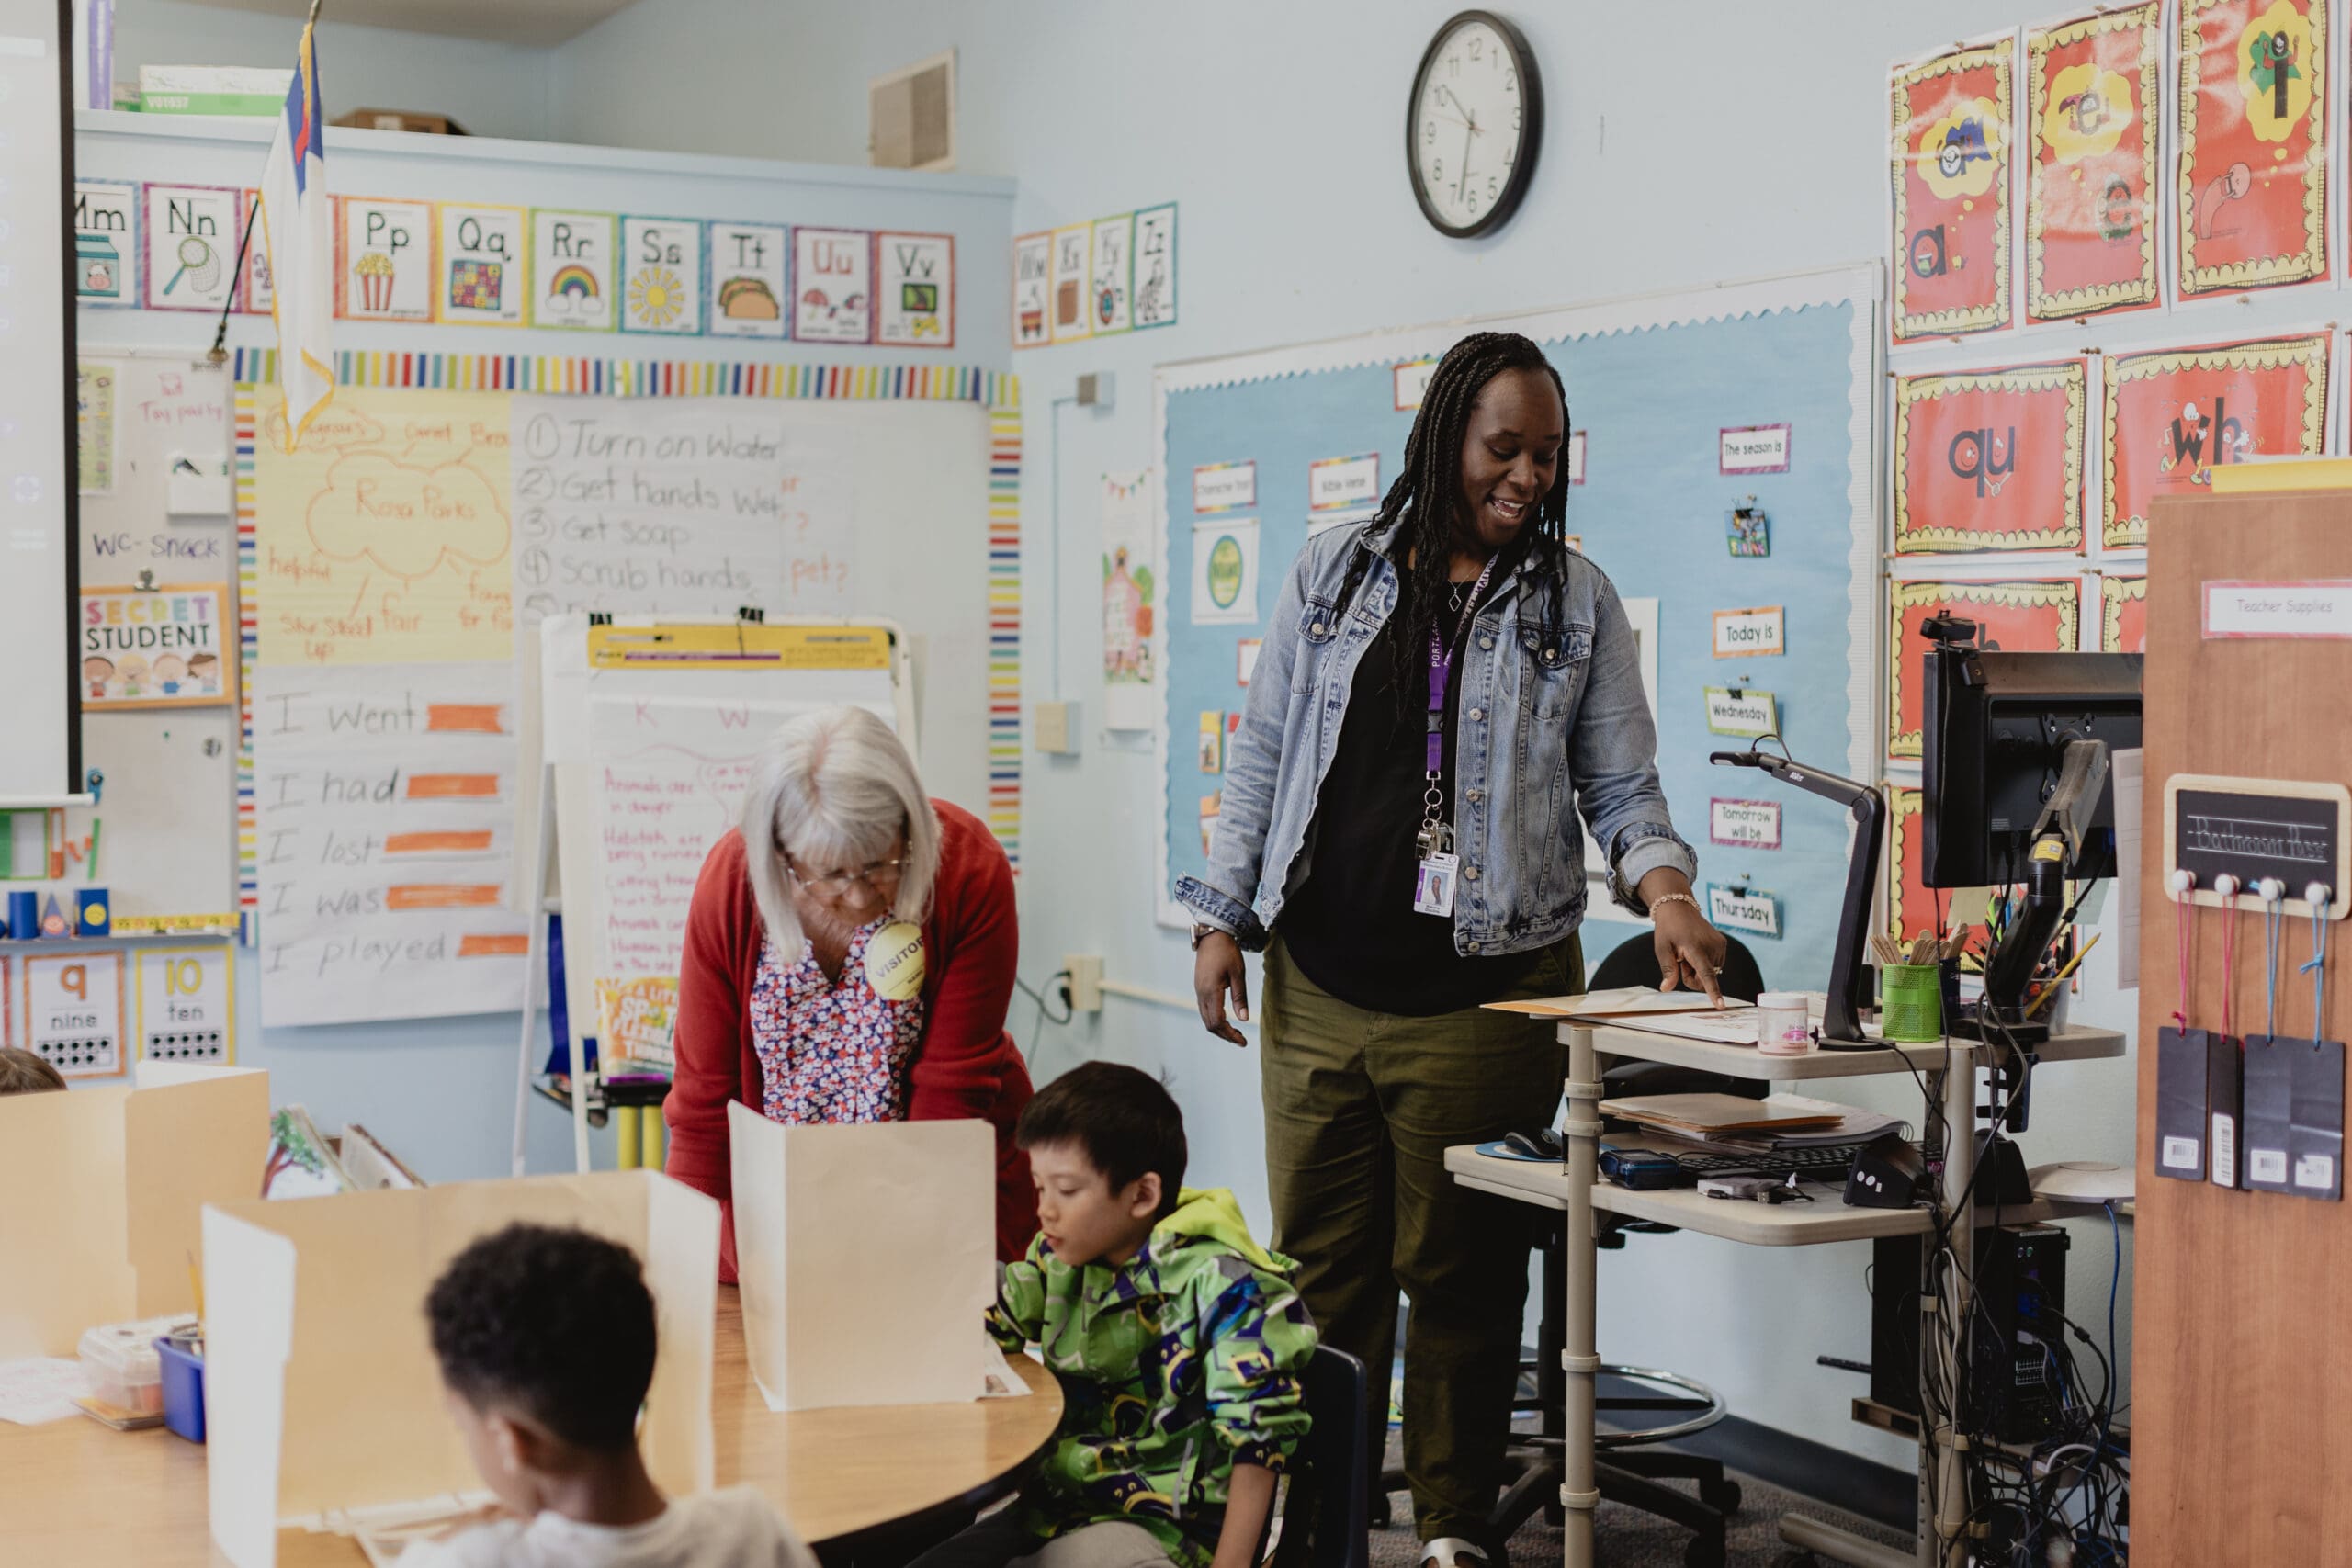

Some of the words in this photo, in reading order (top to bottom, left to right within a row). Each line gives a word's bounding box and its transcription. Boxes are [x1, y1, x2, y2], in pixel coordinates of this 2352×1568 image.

[1469, 38, 1483, 62] 12
[1449, 58, 1460, 78] 11
[1506, 68, 1515, 92] 2
[1434, 85, 1448, 107] 10
[1427, 121, 1436, 145] 9
[1433, 158, 1442, 182] 8
[1468, 190, 1477, 214] 6
[1487, 176, 1497, 200] 5
[169, 199, 216, 236] Nn
[368, 212, 410, 255] Pp
[458, 217, 512, 262] Qq
[552, 222, 594, 258] Rr
[642, 230, 682, 265] Ss
[731, 234, 766, 269] Tt
[812, 239, 853, 275] Uu
[1910, 224, 1946, 278] a
[896, 243, 935, 277] Vv
[569, 419, 646, 459] Turn
[656, 435, 698, 459] on
[1724, 443, 1741, 457] The
[1743, 443, 1773, 456] season
[1774, 441, 1782, 454] is
[2171, 397, 2242, 466] wh
[1948, 426, 2016, 499] qu
[356, 477, 413, 520] Rosa
[422, 484, 476, 521] Parks
[561, 466, 617, 502] Get
[632, 470, 721, 510] hands
[561, 514, 608, 544] Get
[657, 556, 753, 591] hands
[85, 597, 210, 626] SECRET
[2236, 598, 2282, 614] Teacher
[2285, 598, 2333, 615] Supplies
[86, 624, 210, 651] STUDENT
[1431, 612, 1442, 668] PORTLAN
[1726, 625, 1762, 644] Today
[1764, 624, 1773, 641] is
[266, 692, 311, 735] I
[635, 699, 659, 728] K
[718, 706, 751, 730] W
[1712, 702, 1768, 724] Wednesday
[266, 772, 307, 813] I
[322, 767, 400, 805] had
[1722, 806, 1772, 823] Tomorrow
[1731, 823, 1747, 839] will
[1749, 825, 1762, 840] be
[263, 829, 301, 865] I
[2195, 816, 2285, 858] Bathroom
[266, 880, 297, 917] I
[316, 887, 386, 918] was
[1715, 897, 1770, 926] Thursday
[264, 942, 302, 974] I
[318, 931, 447, 978] played
[60, 964, 87, 1001] 9
[165, 958, 203, 997] 10
[51, 1013, 97, 1031] nine
[168, 1001, 205, 1022] ten
